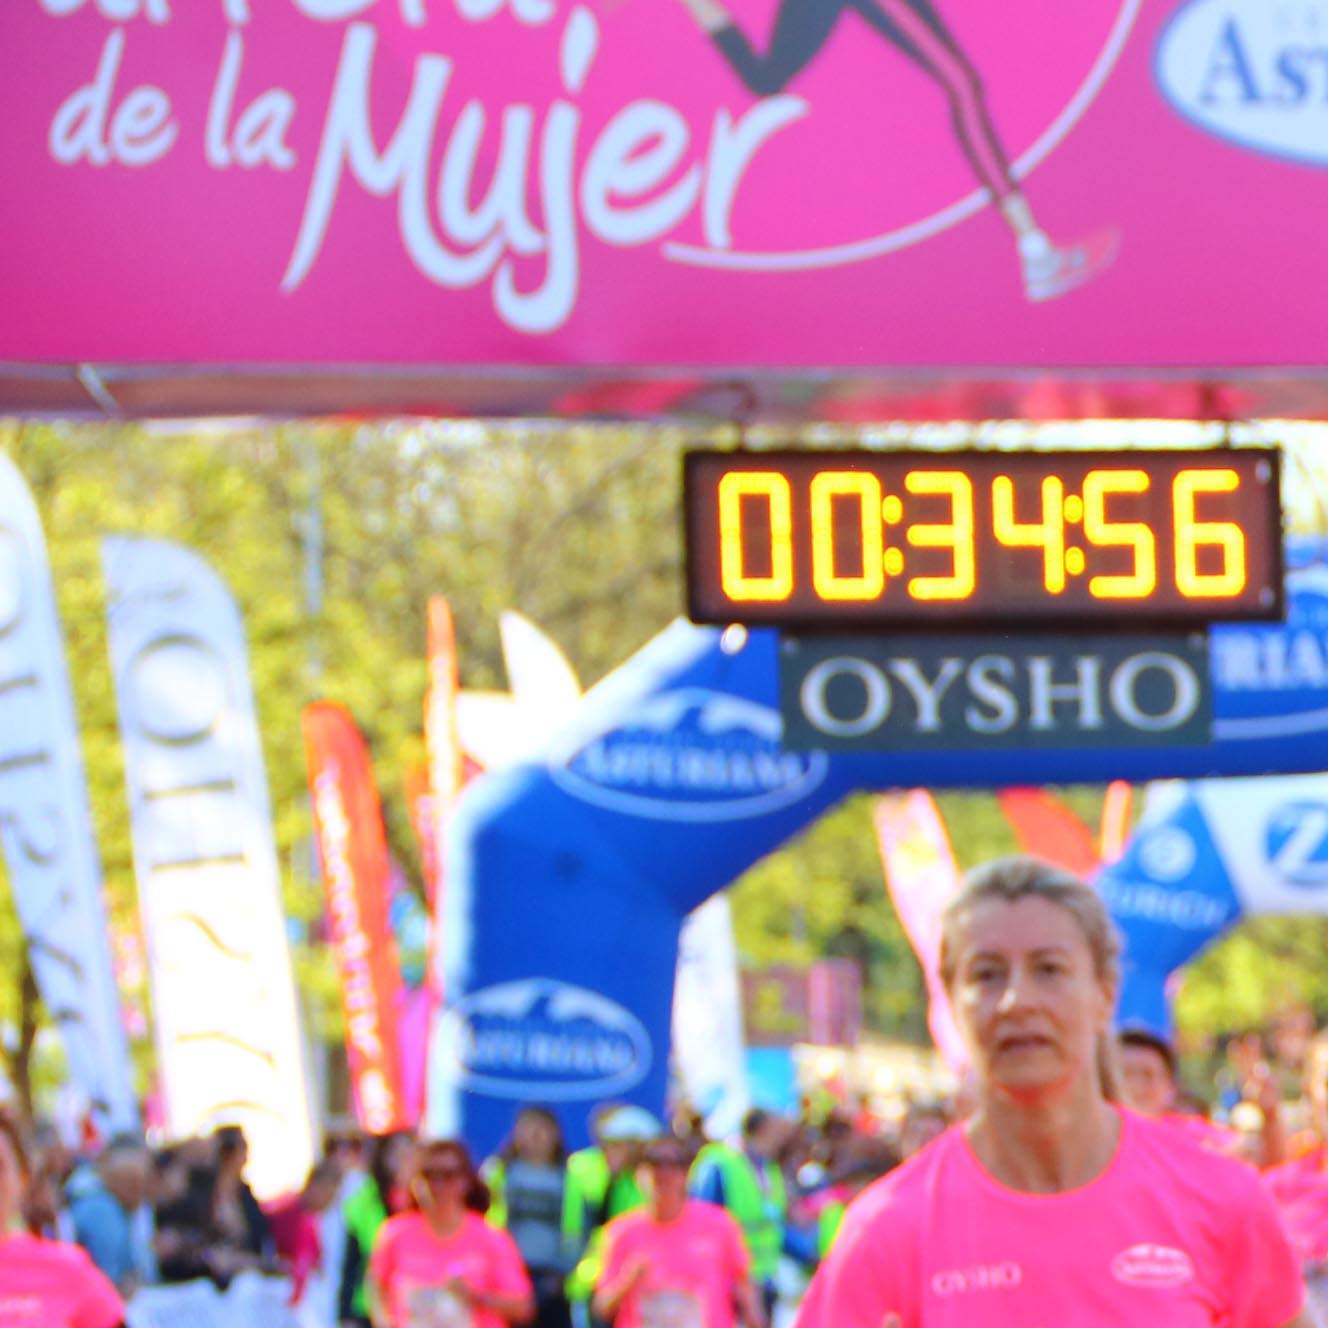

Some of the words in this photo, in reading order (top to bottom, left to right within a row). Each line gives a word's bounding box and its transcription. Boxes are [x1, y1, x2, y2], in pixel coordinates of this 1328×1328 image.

[49, 29, 177, 168] de
[205, 29, 296, 170] la
[281, 8, 809, 333] Mujer
[719, 470, 1245, 602] 00:34:56
[801, 652, 1200, 736] OYSHO
